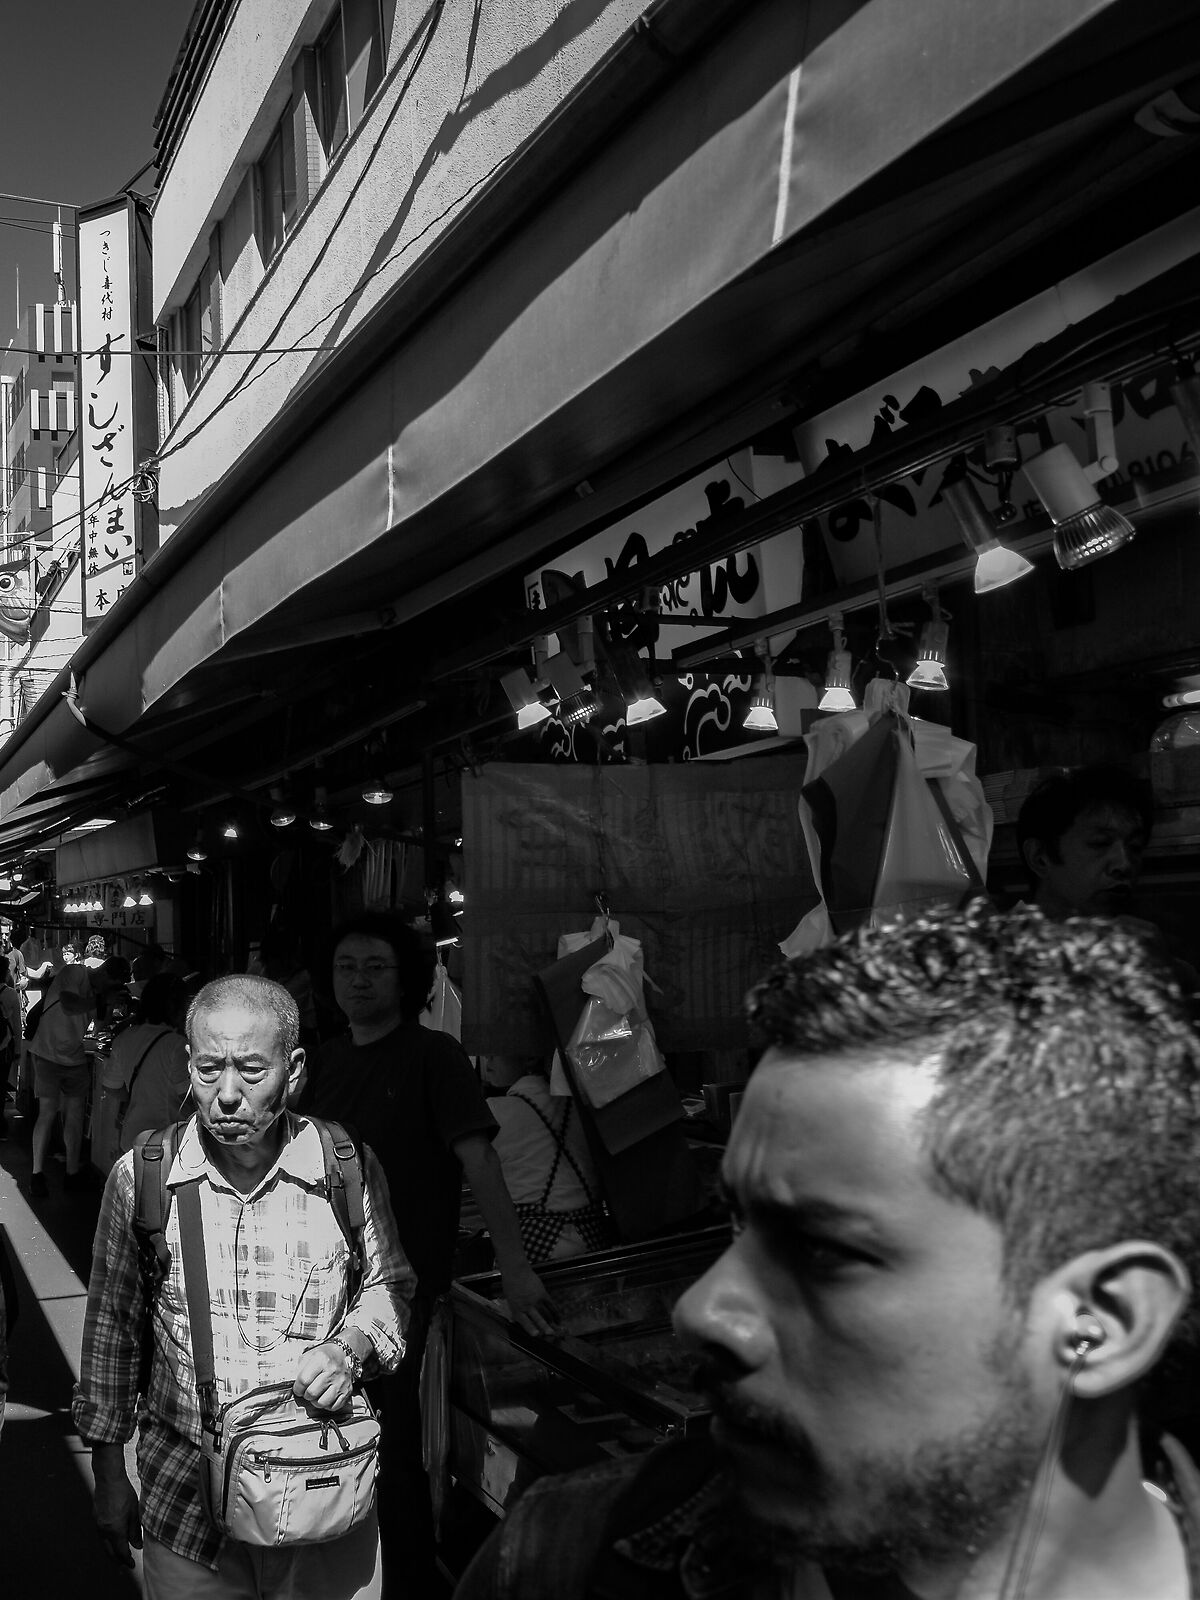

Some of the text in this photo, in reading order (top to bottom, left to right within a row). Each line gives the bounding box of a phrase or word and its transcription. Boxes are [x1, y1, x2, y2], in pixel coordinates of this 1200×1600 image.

[99, 230, 113, 321] つきじ喜代村
[88, 515, 100, 575] 年中無休
